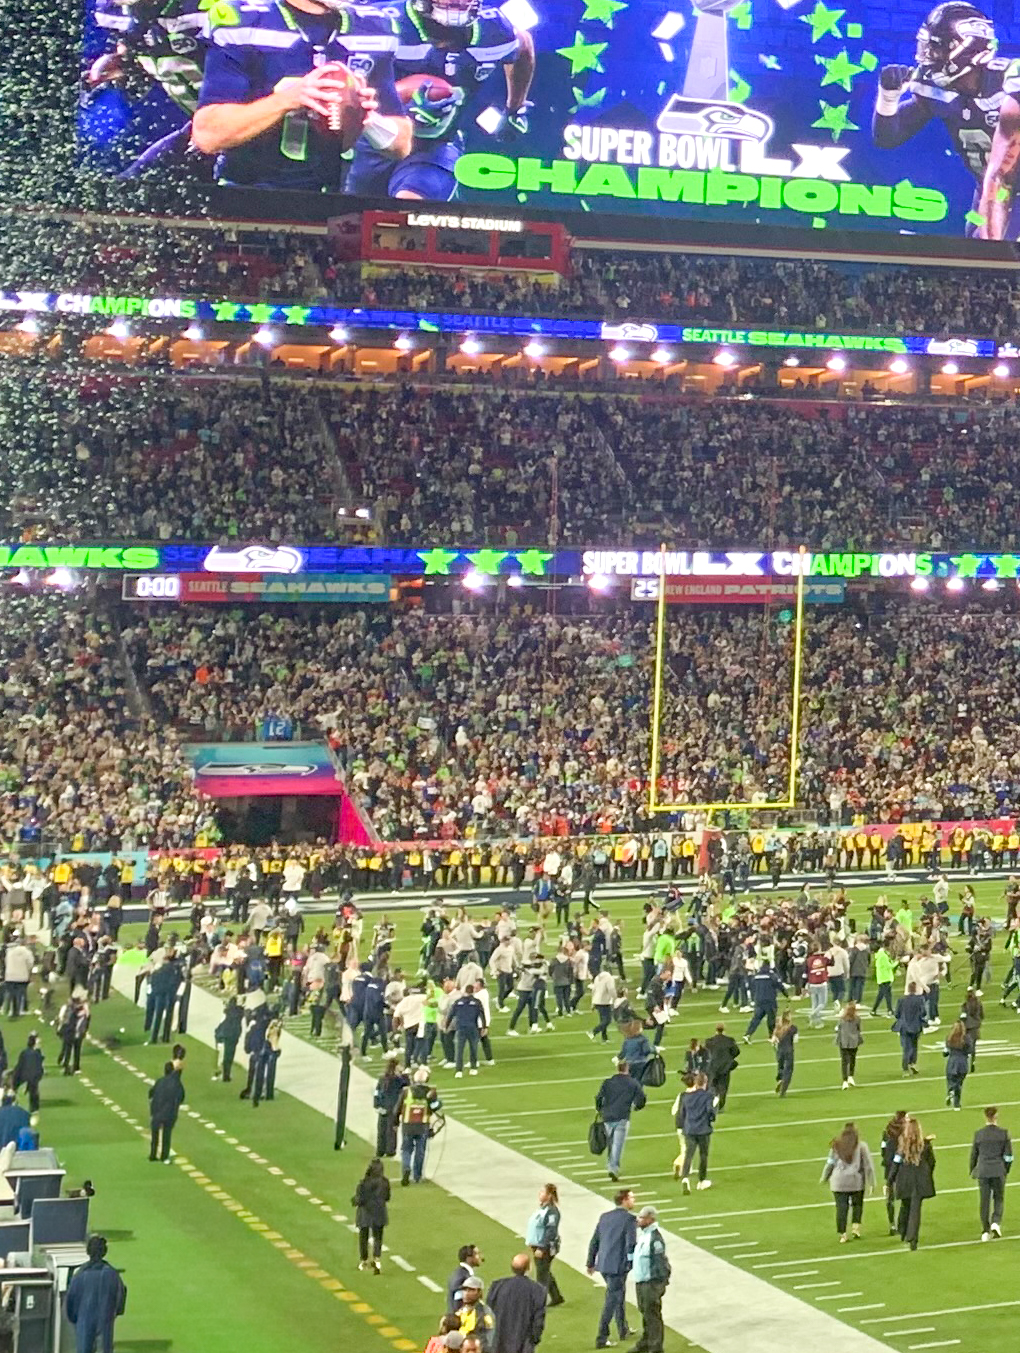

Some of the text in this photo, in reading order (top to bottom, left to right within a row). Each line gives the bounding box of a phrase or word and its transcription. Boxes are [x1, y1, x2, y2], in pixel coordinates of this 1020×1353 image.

[563, 125, 851, 181] SUPER BOWL LX
[454, 153, 948, 222] CHAMPIONS
[461, 217, 521, 232] STADIUM
[56, 295, 197, 317] CHAMPIONS
[682, 328, 908, 353] SEATTLE SEAHAWKS
[582, 551, 932, 576] SUPER BOWL LX CHAMPIONS
[137, 577, 179, 597] 0:00
[189, 581, 386, 593] SEATTLE SEAHAWKS
[634, 580, 658, 597] 25
[685, 584, 721, 594] ENGLAND
[725, 584, 841, 595] PATRIOTS
